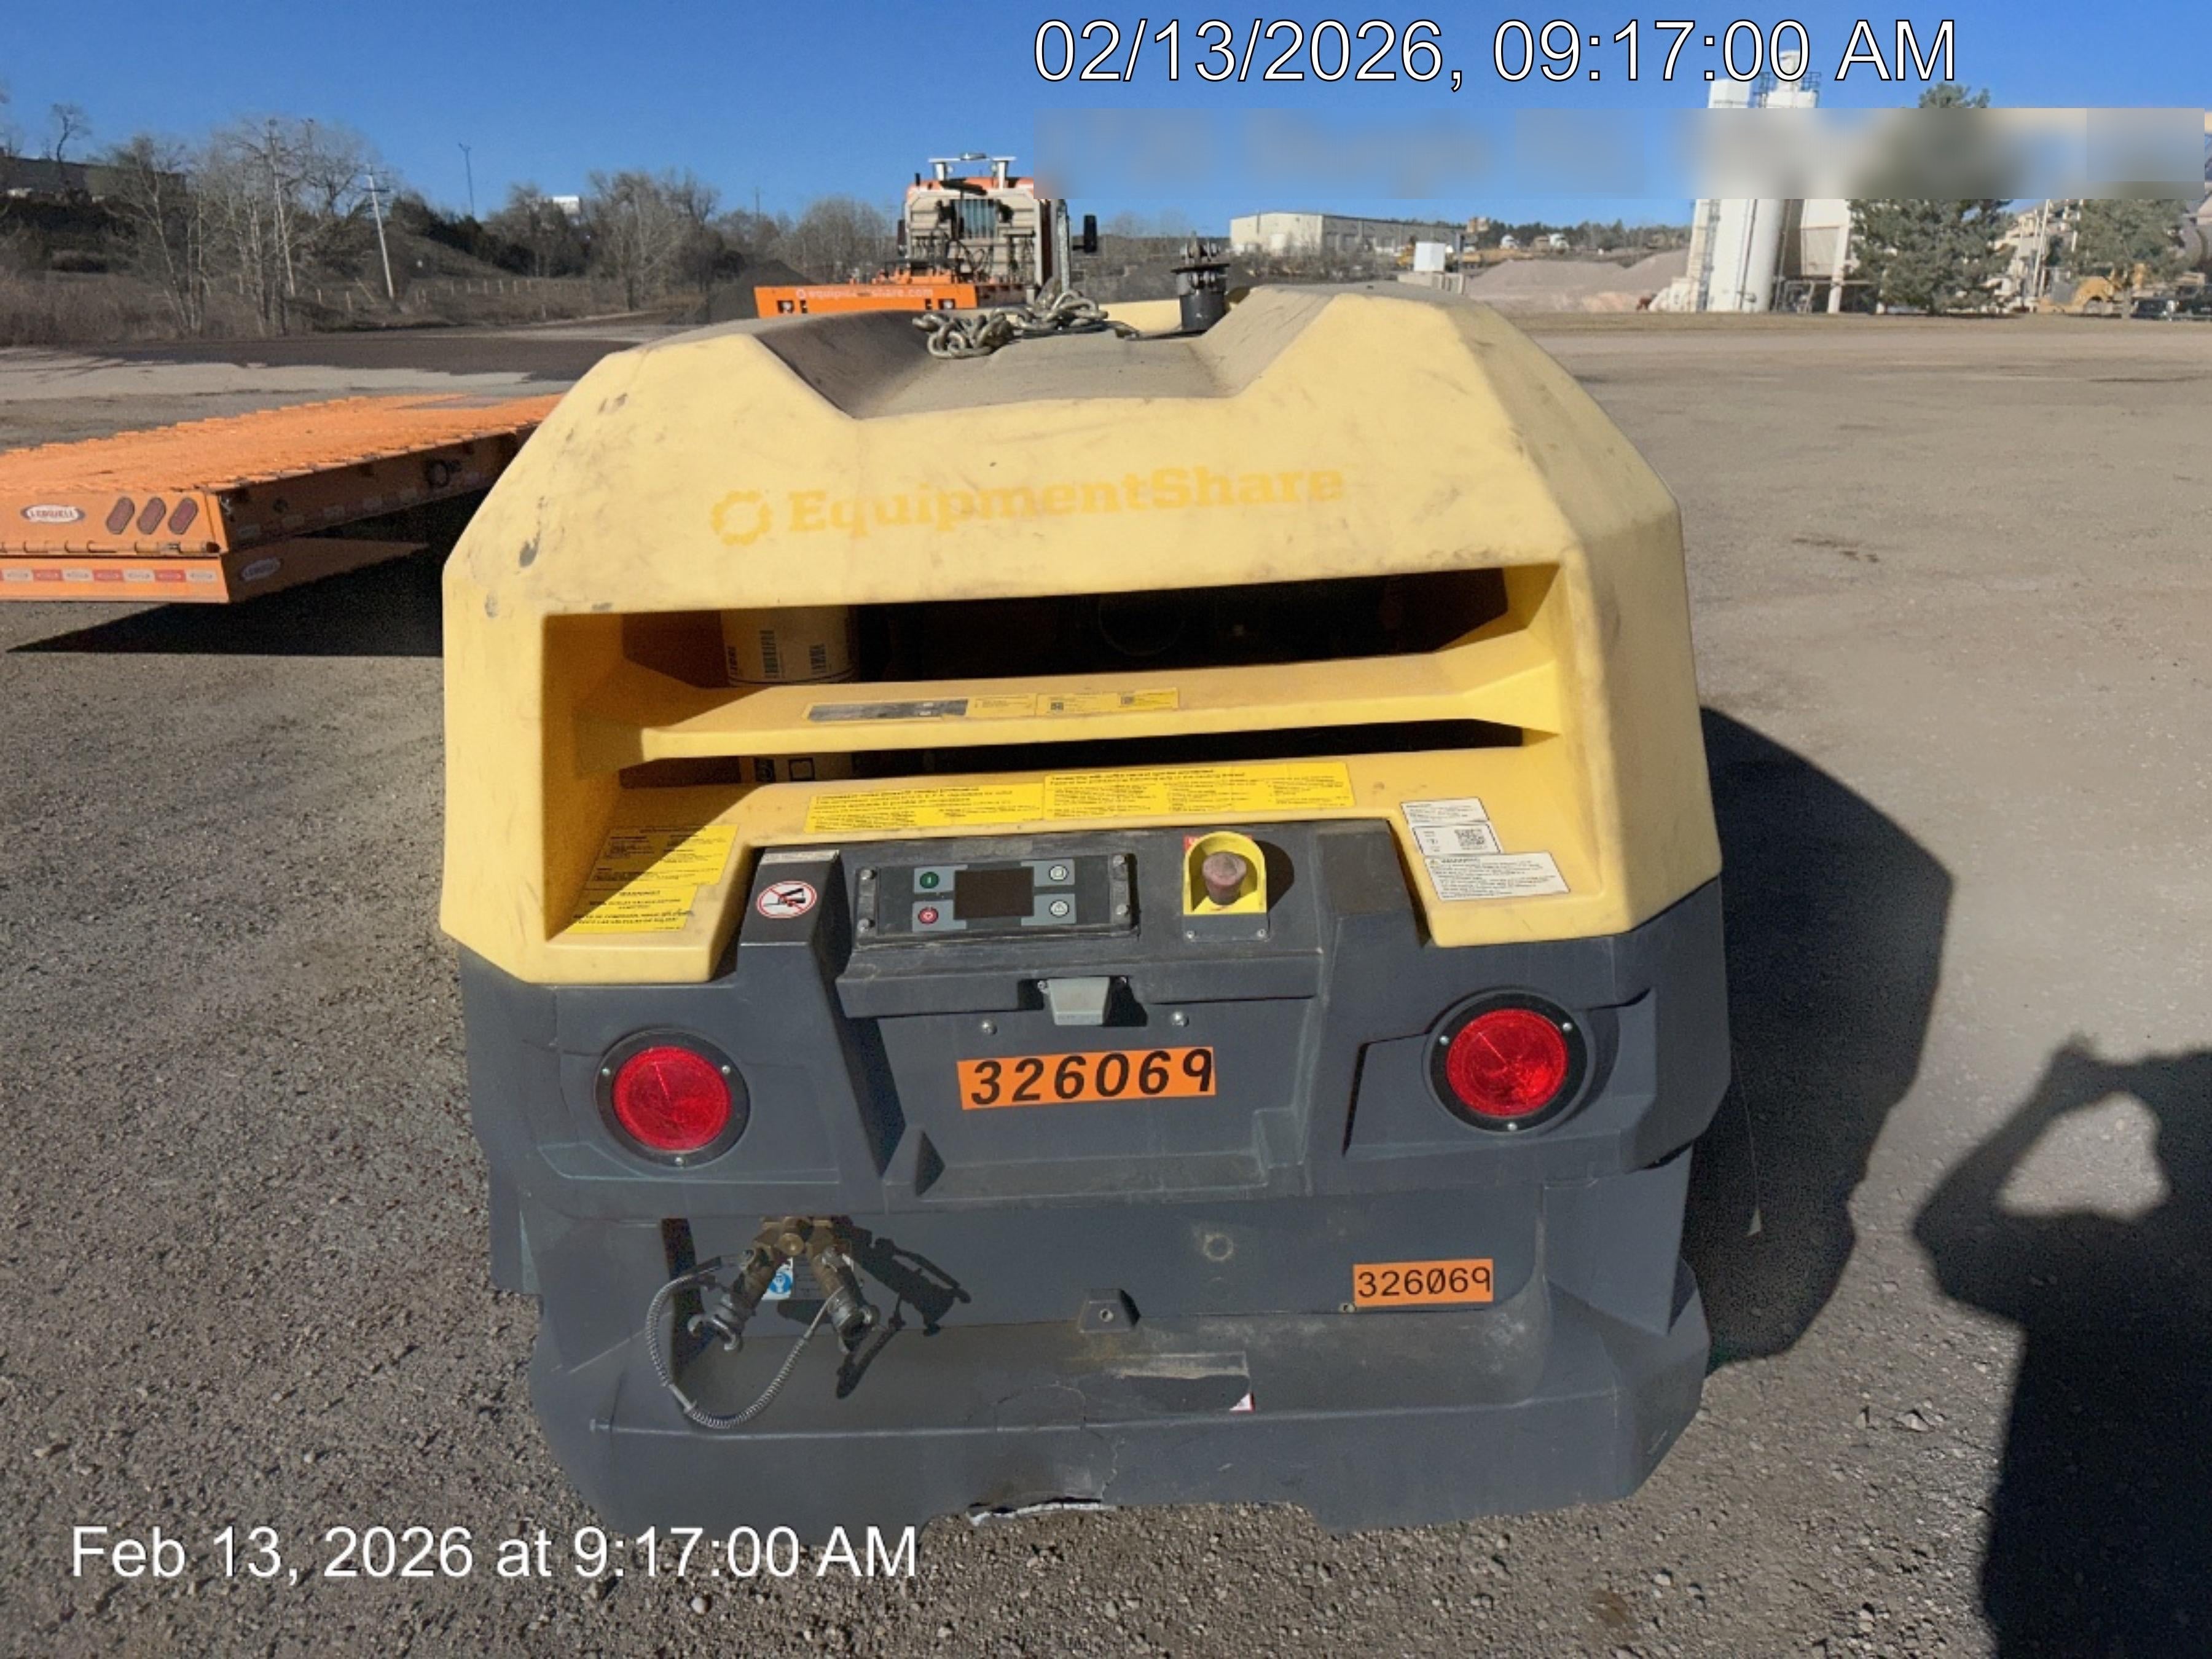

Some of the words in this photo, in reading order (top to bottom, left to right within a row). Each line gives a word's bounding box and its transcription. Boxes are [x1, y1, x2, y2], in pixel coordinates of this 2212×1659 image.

[787, 464, 1344, 539] EquipmentShare
[970, 1048, 1213, 1105] 326069
[1357, 1266, 1491, 1298] 326069
